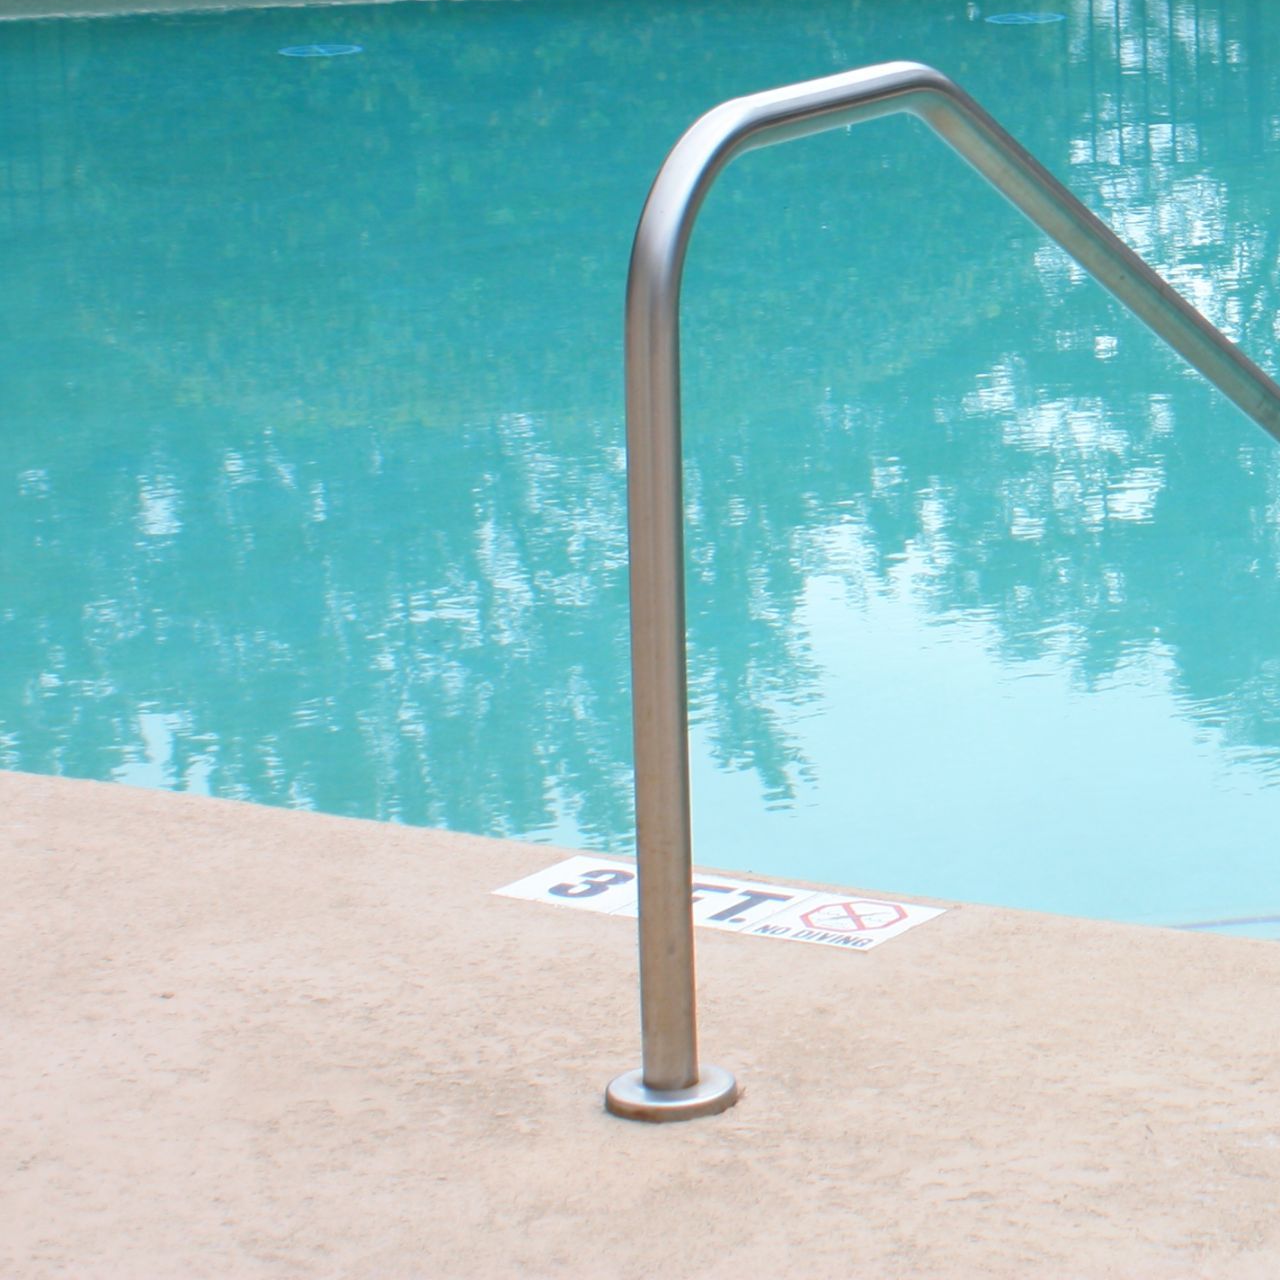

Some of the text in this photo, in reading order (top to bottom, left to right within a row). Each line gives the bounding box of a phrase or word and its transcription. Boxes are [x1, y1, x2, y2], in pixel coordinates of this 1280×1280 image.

[547, 869, 636, 898] 3
[754, 924, 874, 948] NO DIVING
